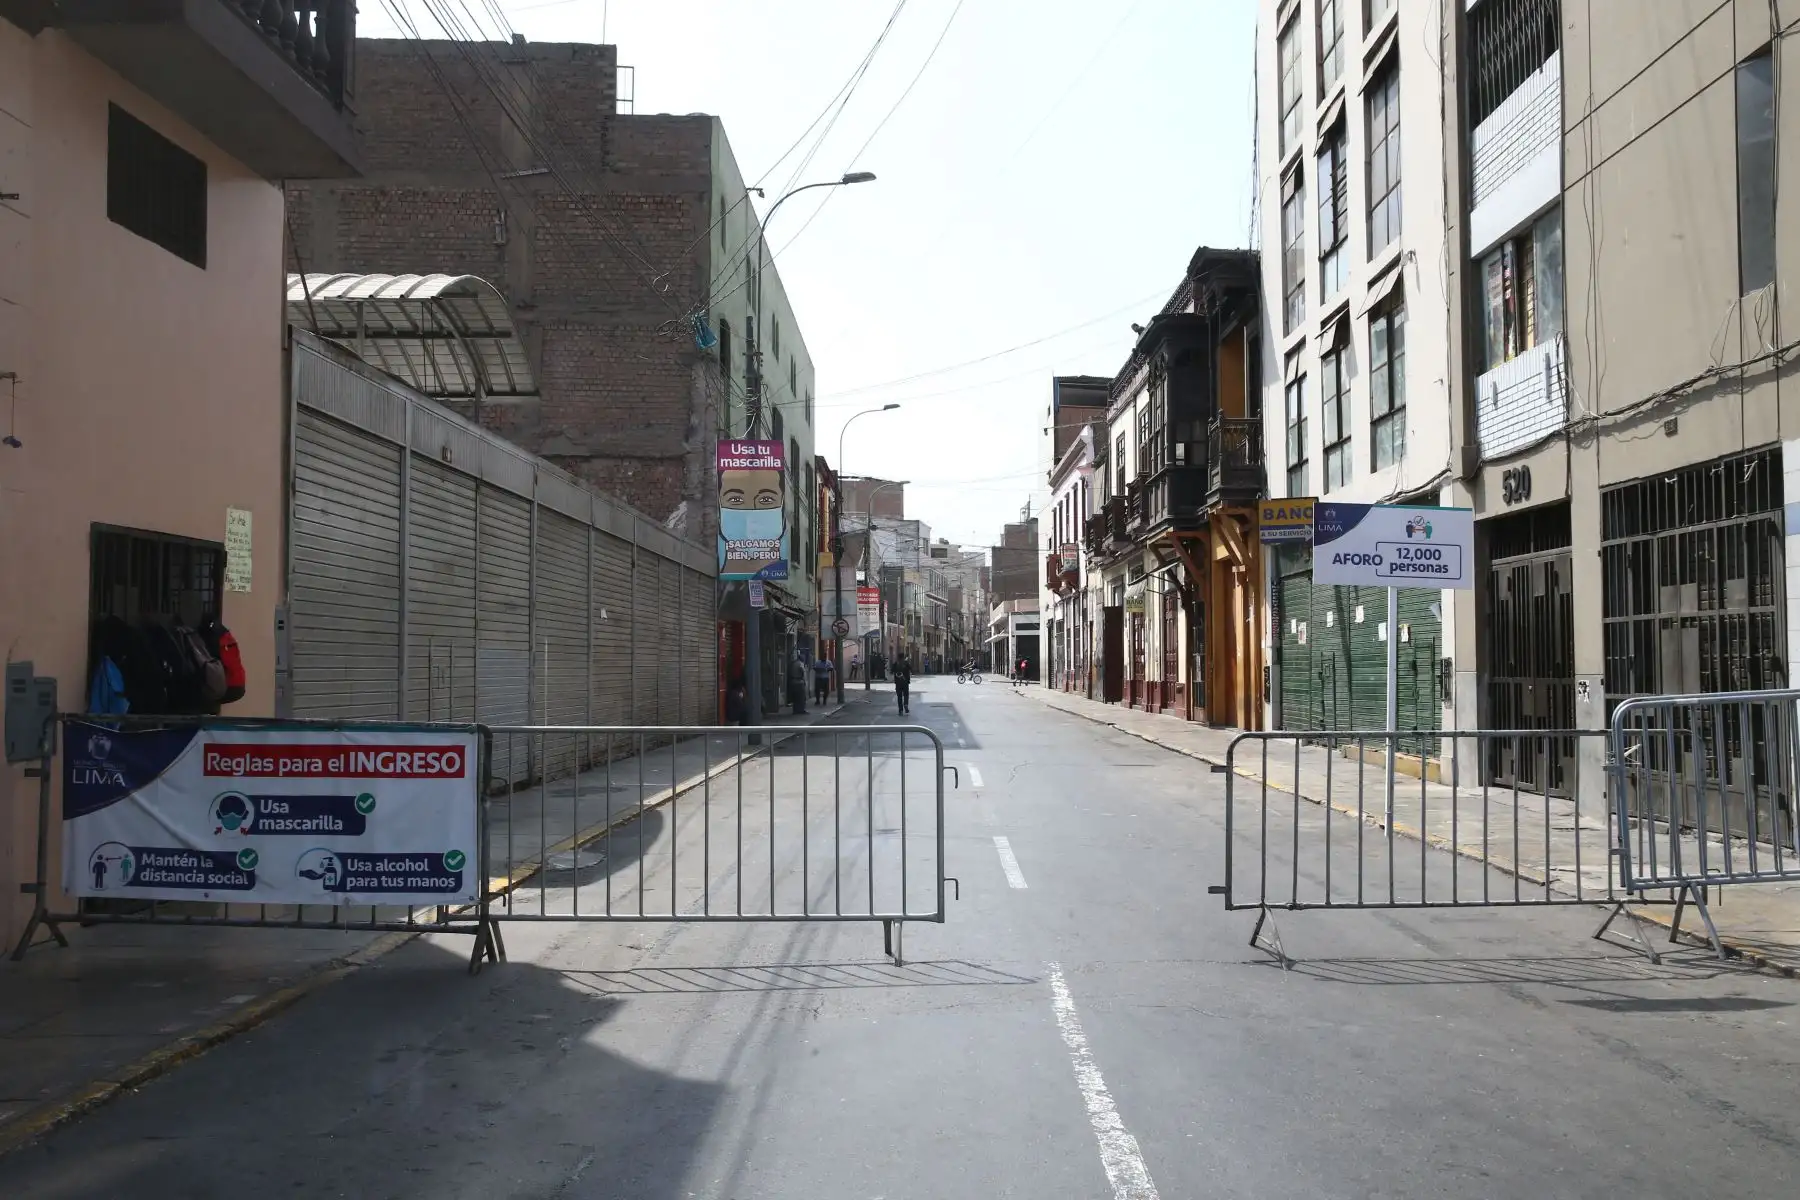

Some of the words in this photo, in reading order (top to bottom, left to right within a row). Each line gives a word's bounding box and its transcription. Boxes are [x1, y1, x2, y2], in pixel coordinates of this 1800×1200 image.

[731, 443, 755, 455] Usa
[758, 444, 770, 455] tu
[720, 456, 781, 467] mascarilla
[1502, 465, 1532, 507] 520
[1318, 524, 1343, 532] LIMA
[726, 540, 780, 551] ¡SALGAMOS
[727, 551, 751, 560] BIEN,
[754, 550, 780, 560] PERÚ!
[1332, 552, 1383, 566] AFORO
[1396, 547, 1442, 561] 12,000
[1389, 560, 1449, 574] personas
[207, 752, 274, 776] Reglas
[278, 757, 323, 776] para
[328, 753, 344, 772] el
[350, 751, 461, 774] INGRESO
[73, 768, 126, 787] LIMA
[260, 799, 290, 814] Usa
[258, 815, 343, 831] mascarilla
[141, 853, 198, 868] Mantén
[201, 855, 214, 868] la
[347, 858, 372, 872] Usa
[375, 858, 429, 872] alcohol
[140, 869, 205, 884] distancia
[207, 871, 249, 885] social
[346, 877, 379, 890] para
[381, 876, 404, 888] tus
[407, 877, 455, 888] manos
